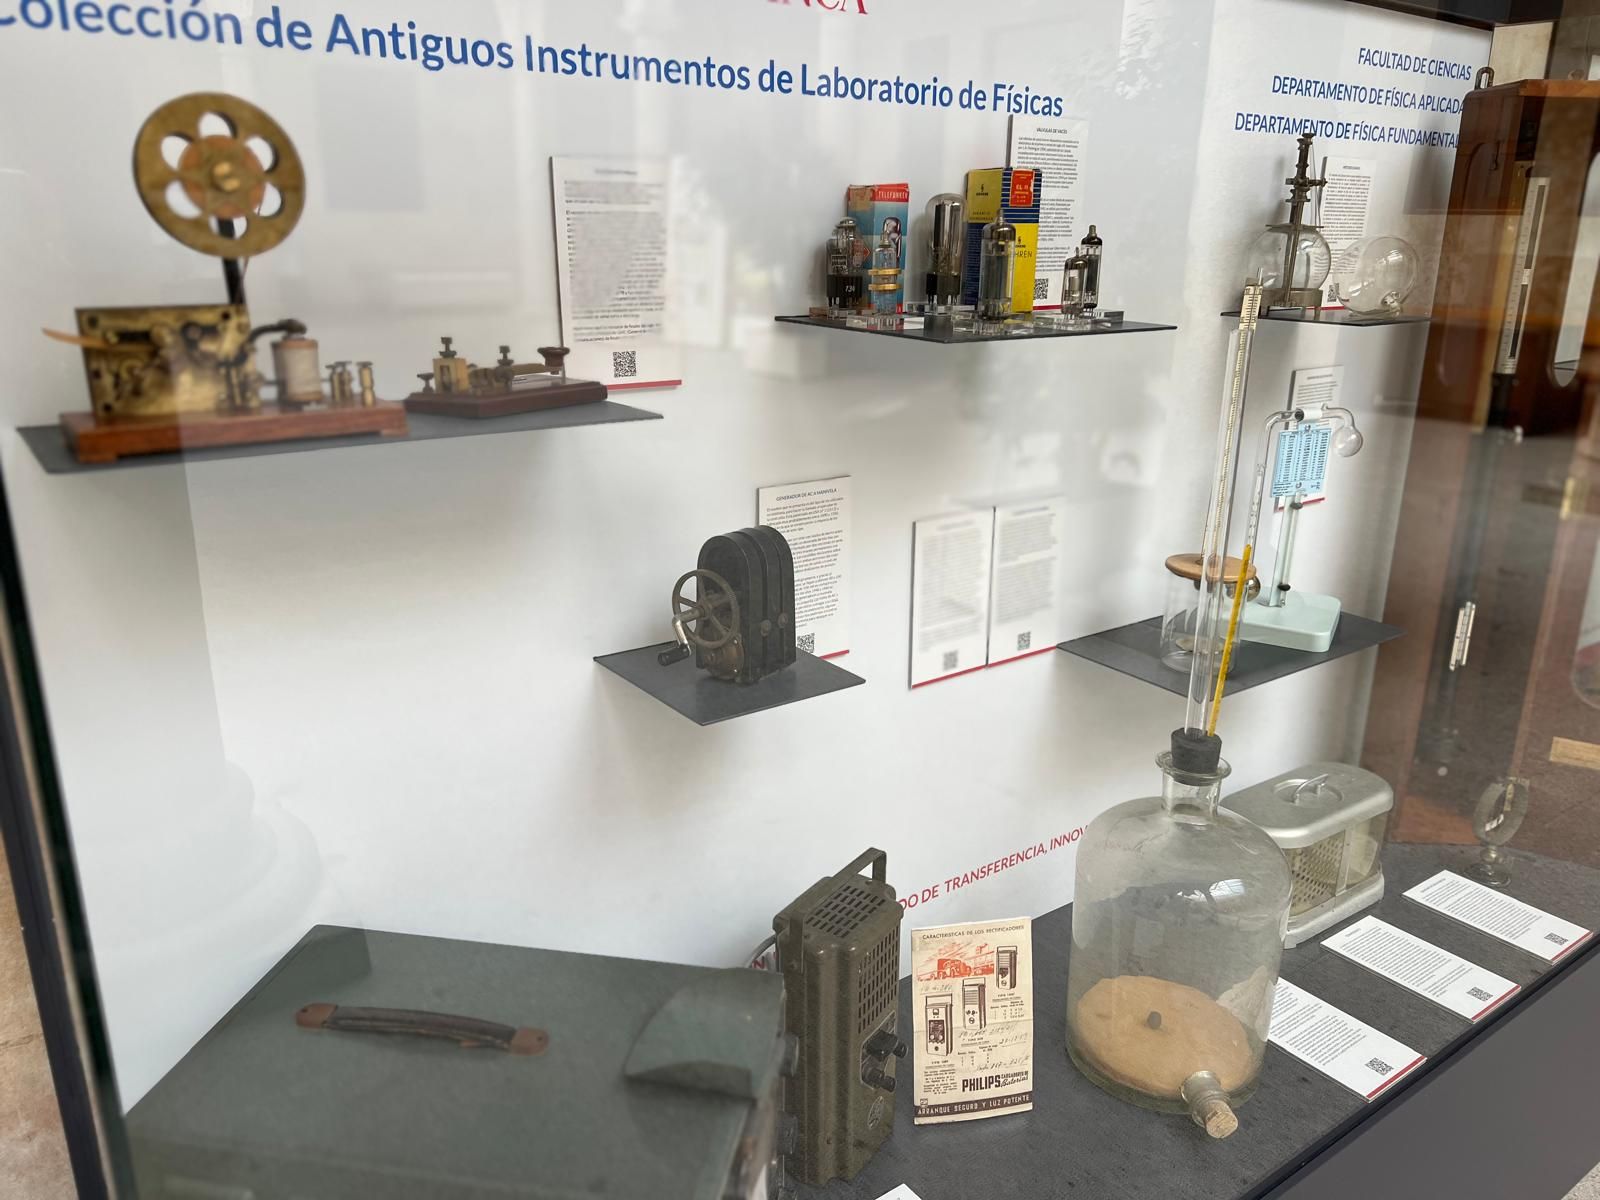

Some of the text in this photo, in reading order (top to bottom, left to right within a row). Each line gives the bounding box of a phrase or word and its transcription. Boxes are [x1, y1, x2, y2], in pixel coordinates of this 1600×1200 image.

[0, 0, 1063, 118] olección de Antiguos Instrumentos de Laboratorio de Físicas
[1358, 47, 1472, 81] FACULTAD DE CIENCIAS
[1271, 75, 1368, 104] DEPARTAMENTO
[1368, 87, 1383, 105] DE
[1384, 86, 1417, 110] FÍSICA
[1234, 112, 1334, 138] DEPARTAMENTO
[1335, 122, 1352, 140] DE
[1352, 120, 1387, 143] FÍSICA
[921, 884, 940, 904] DE
[944, 842, 1048, 894] TRANSFERENCIA,
[962, 1074, 1001, 1093] PHILIPS
[917, 1105, 951, 1115] ARRANQUE
[954, 1102, 978, 1112] SEGURO
[989, 1099, 1001, 1108] LUZ
[1003, 1094, 1030, 1105] POTENTE
